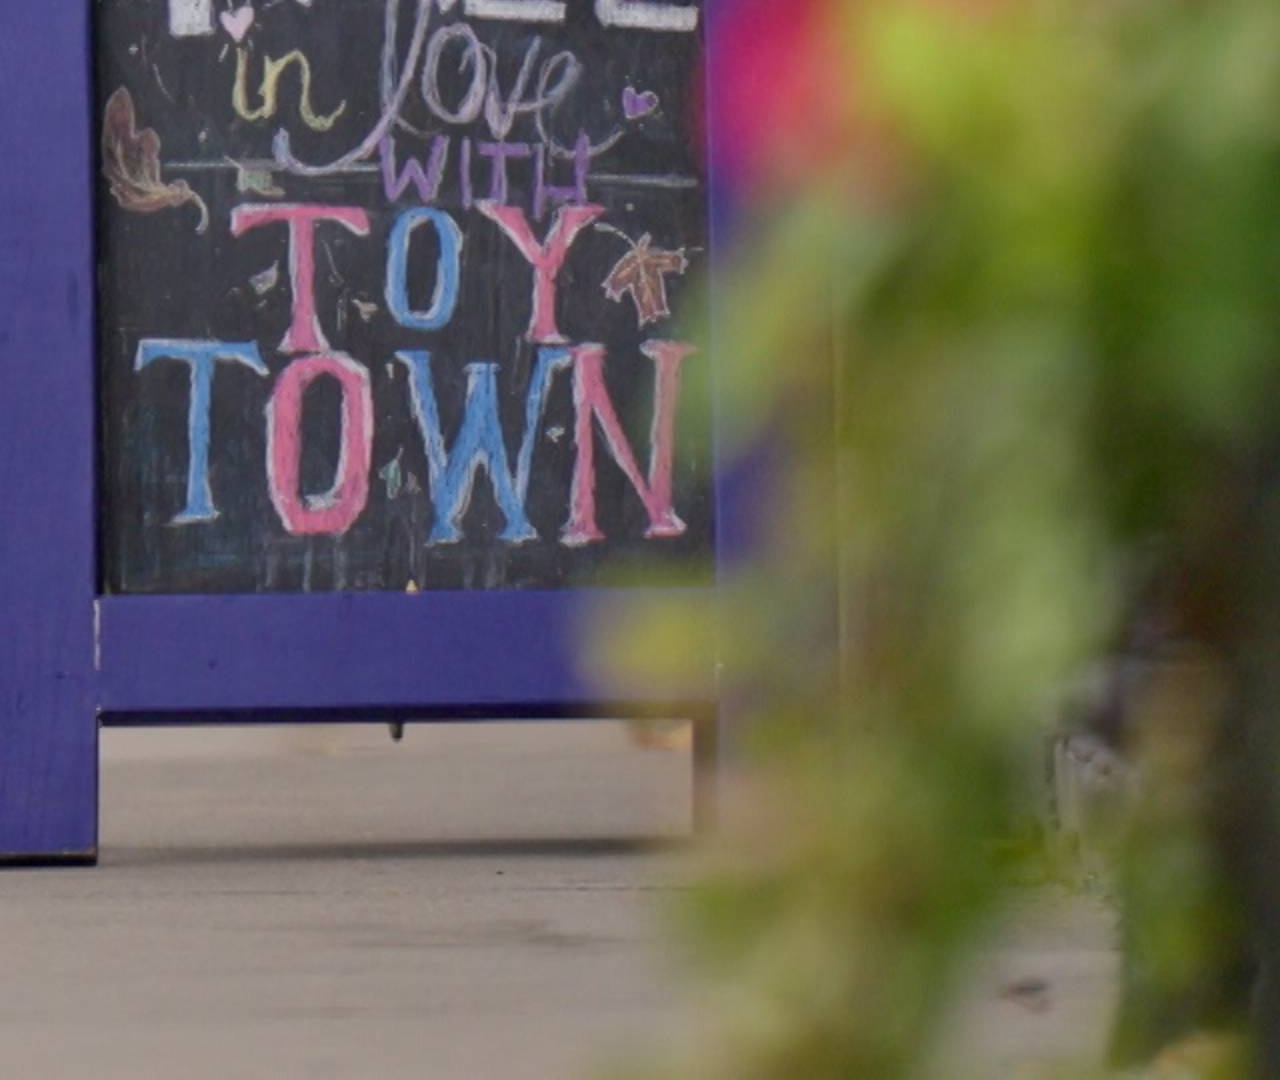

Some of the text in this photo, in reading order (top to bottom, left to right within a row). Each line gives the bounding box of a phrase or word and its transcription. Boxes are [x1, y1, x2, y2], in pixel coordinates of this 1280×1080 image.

[218, 3, 348, 133] in
[378, 127, 592, 219] WITH
[229, 199, 607, 355] TOY
[133, 337, 701, 548] TOWN
